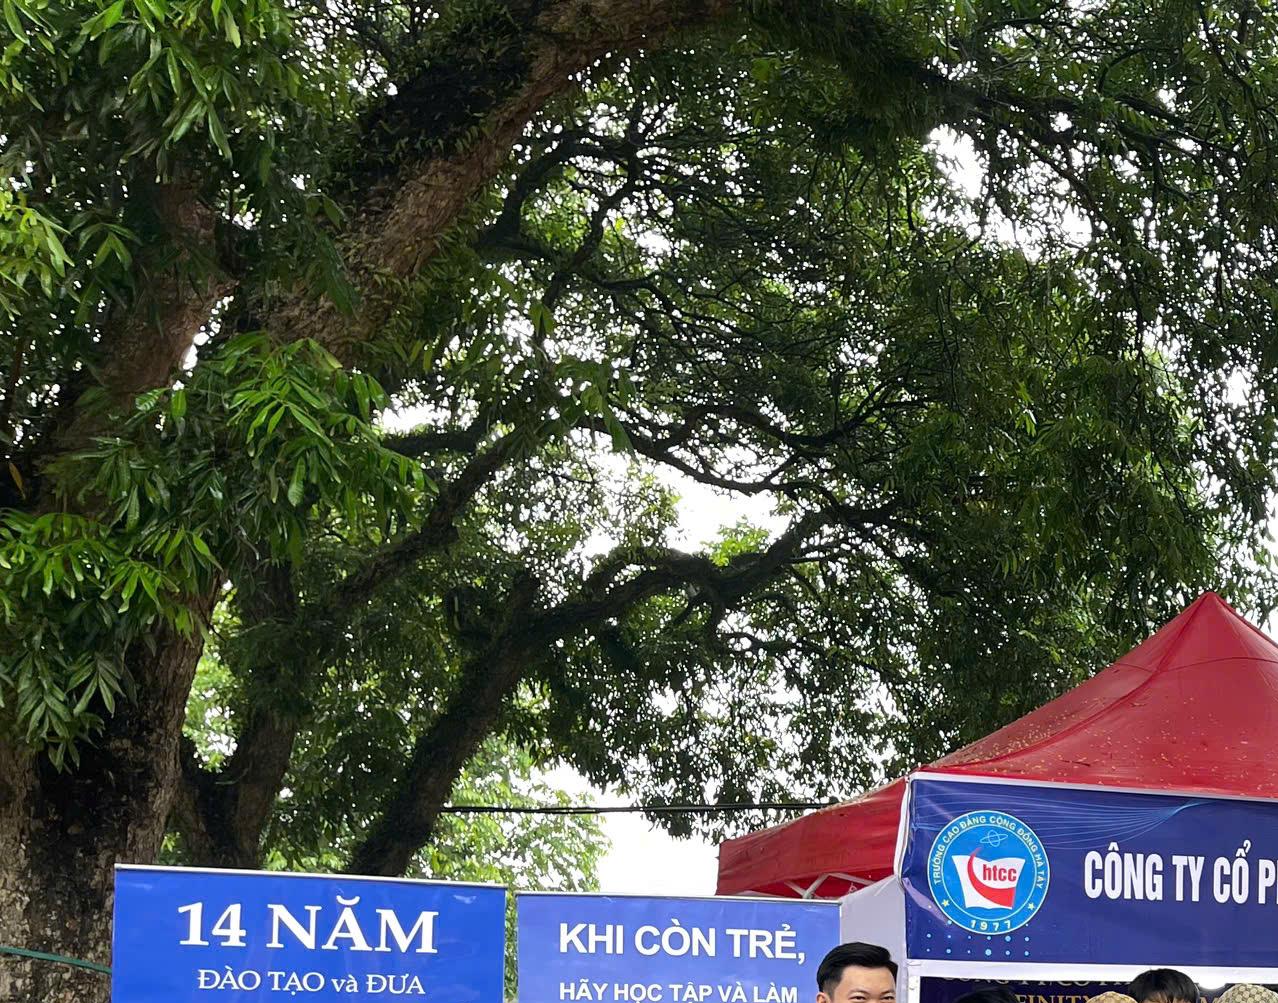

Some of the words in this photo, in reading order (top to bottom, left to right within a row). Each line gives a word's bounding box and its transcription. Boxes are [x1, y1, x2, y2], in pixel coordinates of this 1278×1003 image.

[942, 826, 960, 844] CAO
[982, 864, 1017, 882] htcc
[1084, 842, 1164, 901] CÔNG
[1171, 854, 1205, 902] TY
[1213, 840, 1251, 904] CỔ
[178, 902, 247, 948] 14
[266, 896, 438, 954] NĂM
[970, 920, 1012, 931] 1977
[559, 922, 624, 954] KHI
[634, 918, 717, 957] CÒN
[726, 923, 806, 965] TRẺ,
[198, 965, 261, 990] ĐÀO
[268, 972, 324, 996] TẠO
[332, 973, 358, 993] và
[366, 973, 426, 995] ĐƯA
[558, 978, 608, 1002] HÃY
[716, 981, 748, 1003] VÀ
[752, 984, 798, 1003] LÀM
